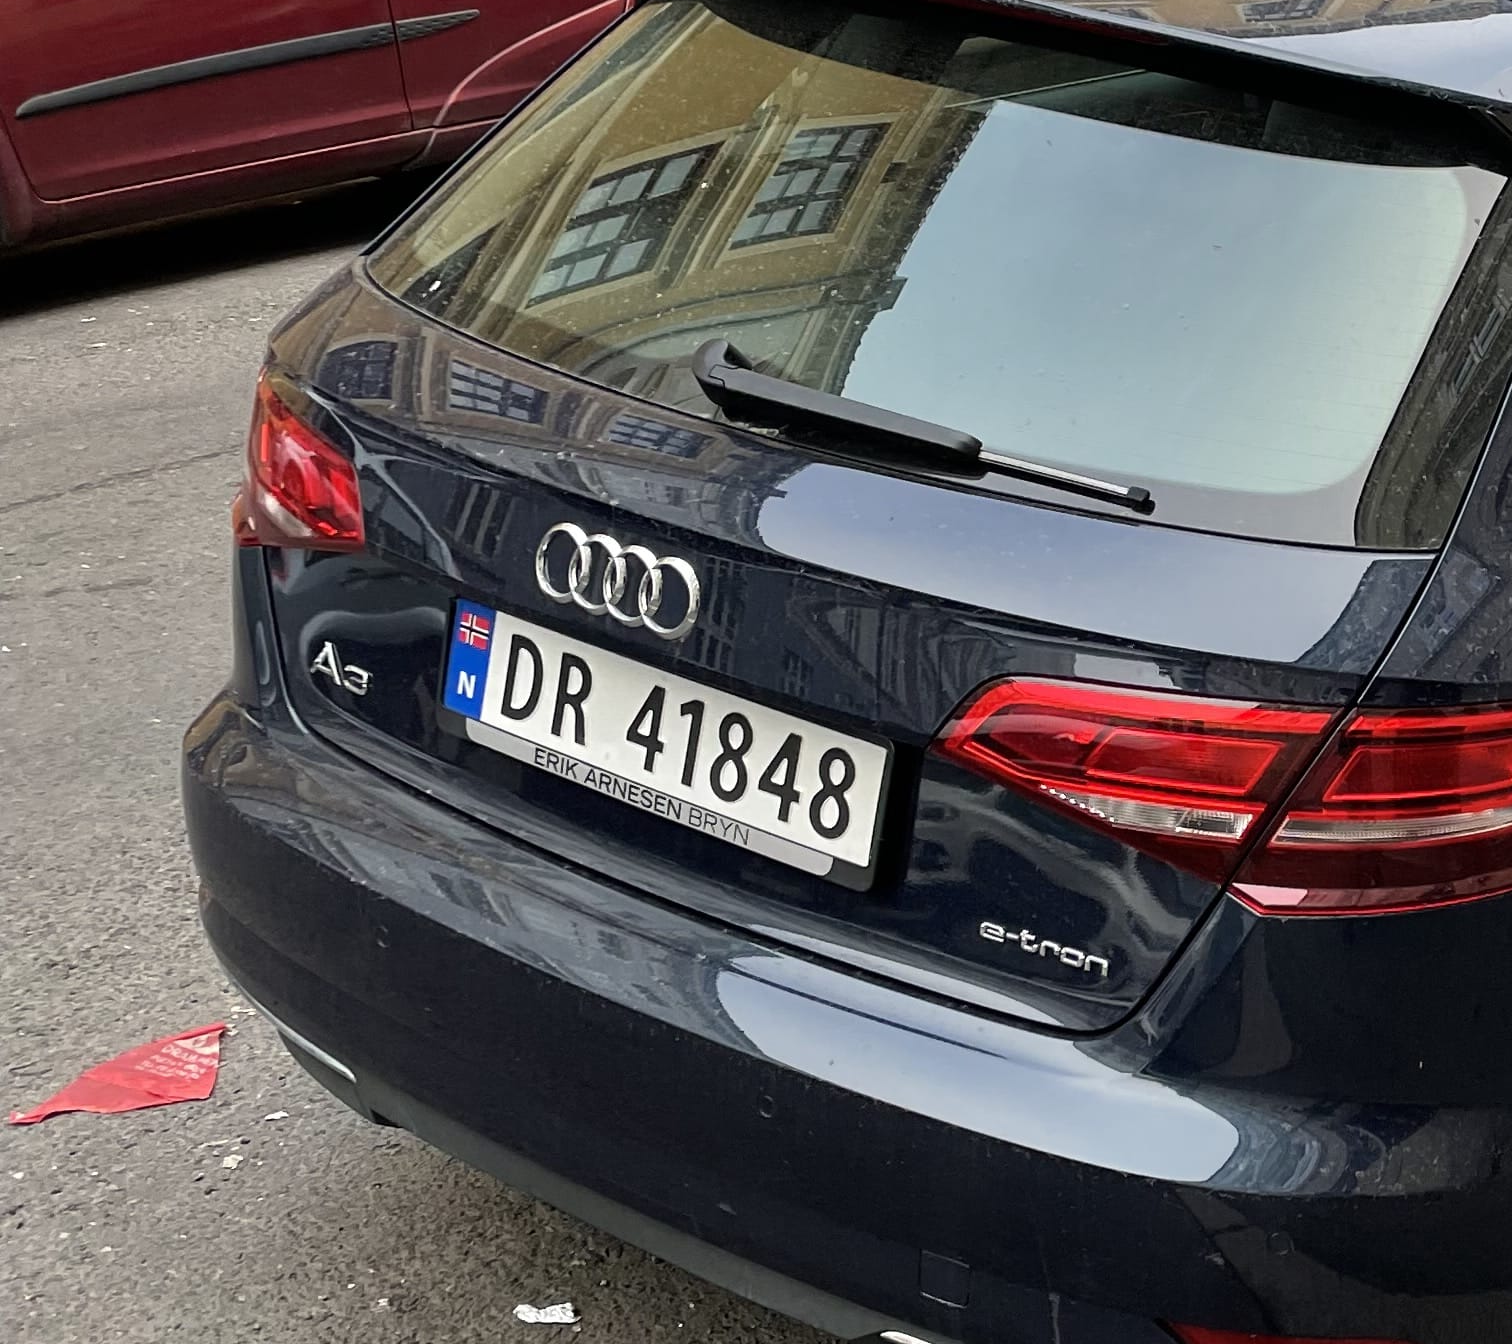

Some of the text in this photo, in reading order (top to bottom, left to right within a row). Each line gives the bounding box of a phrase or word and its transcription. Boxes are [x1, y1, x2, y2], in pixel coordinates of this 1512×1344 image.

[309, 640, 372, 696] A3
[457, 670, 476, 699] N
[501, 633, 856, 840] DR 41848
[533, 747, 750, 846] ERIK ARNESEN BRYN
[979, 921, 1109, 977] e-tron
